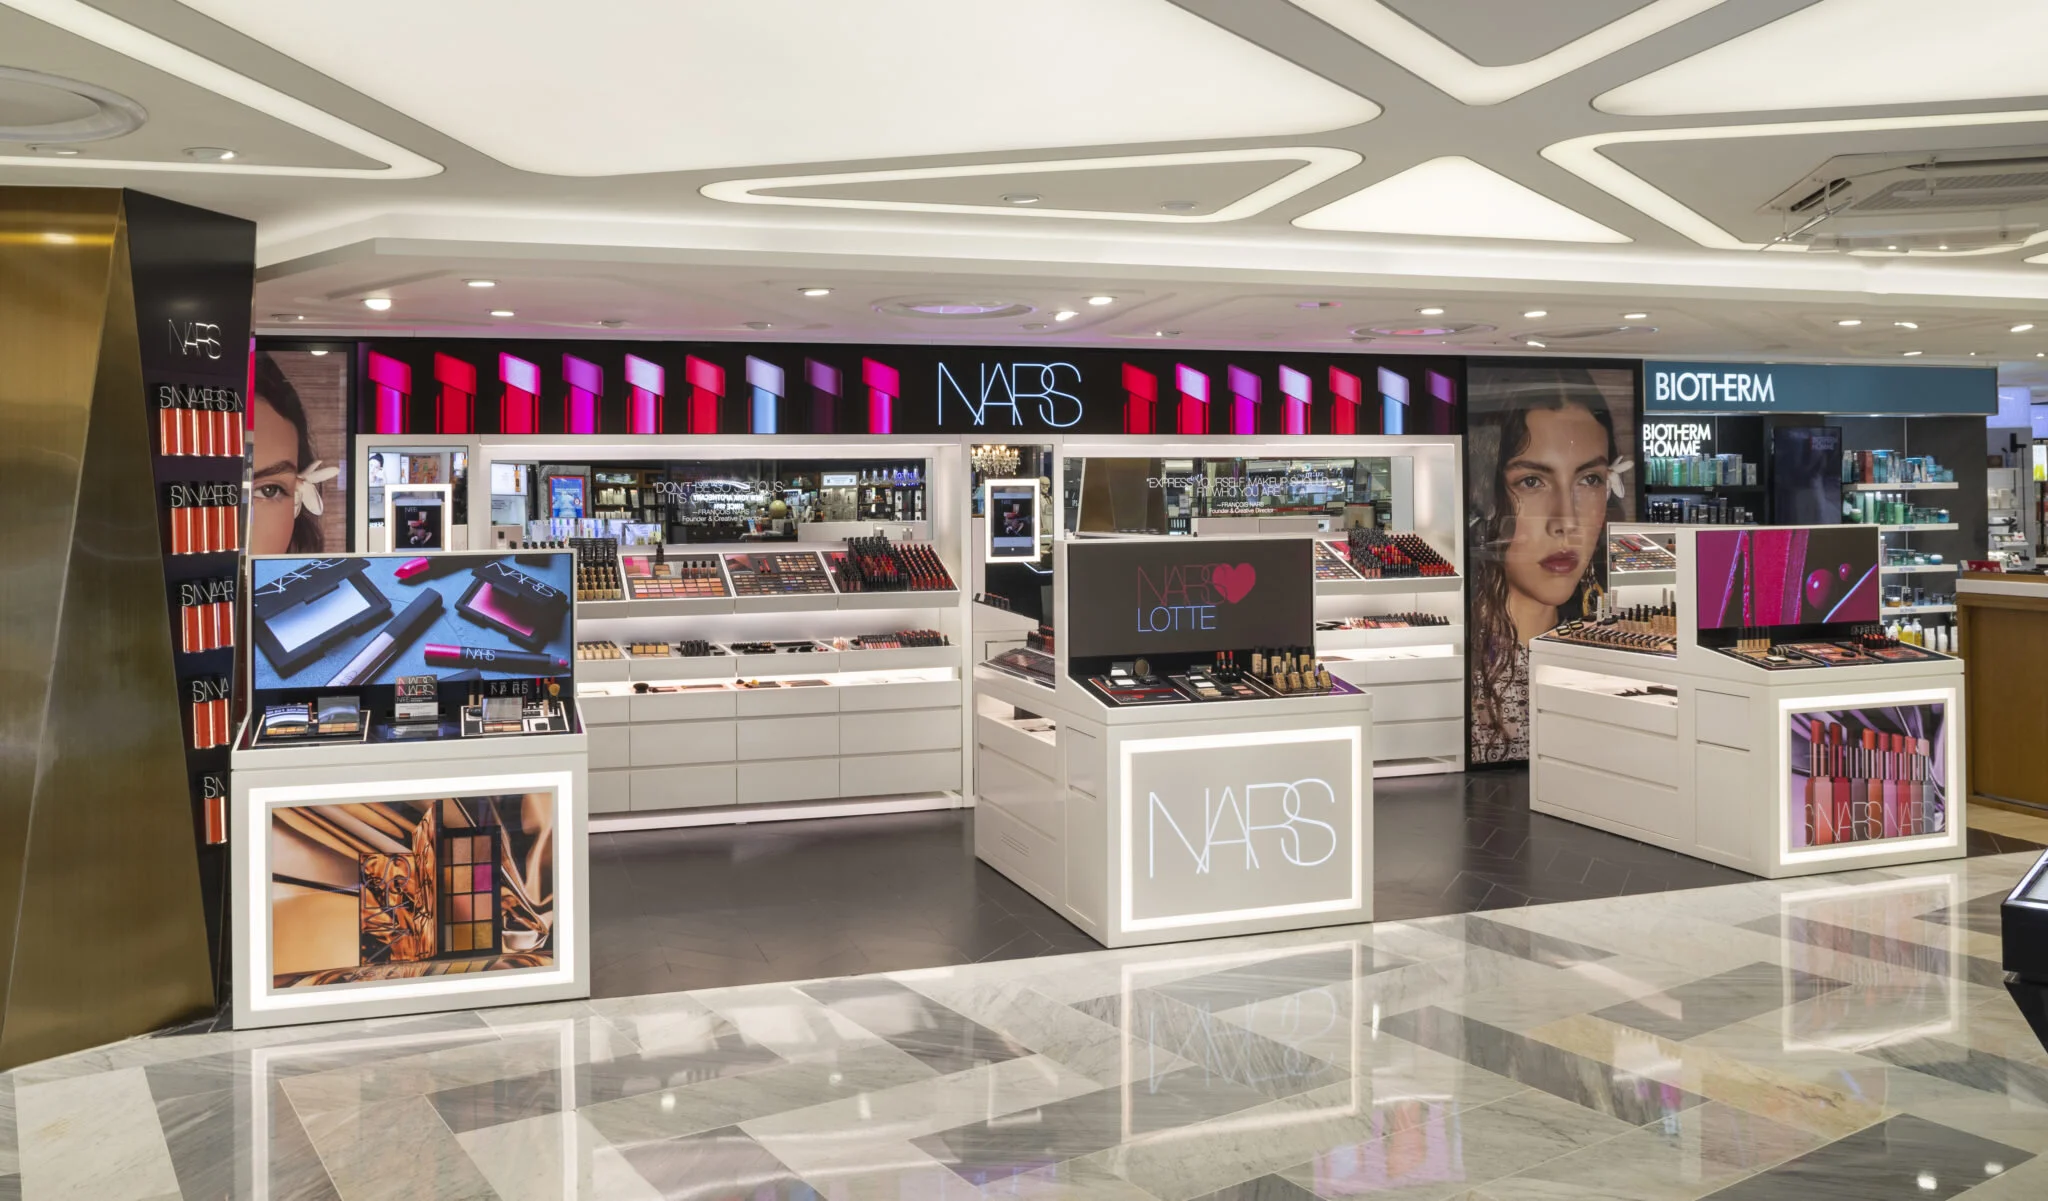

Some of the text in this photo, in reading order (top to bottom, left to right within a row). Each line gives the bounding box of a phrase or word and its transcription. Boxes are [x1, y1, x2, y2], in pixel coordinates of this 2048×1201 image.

[168, 318, 222, 360] NARS
[938, 361, 1083, 428] NARS
[1655, 371, 1775, 403] BIOTHERM
[1642, 423, 1712, 441] BIOTHERM
[1642, 439, 1701, 457] HOMME
[1211, 487, 1237, 498] WHO
[1238, 487, 1258, 497] YOU
[485, 562, 557, 598] NARS
[1137, 563, 1229, 606] NARS
[1137, 604, 1216, 633] LOTTE
[1149, 777, 1337, 879] NARS
